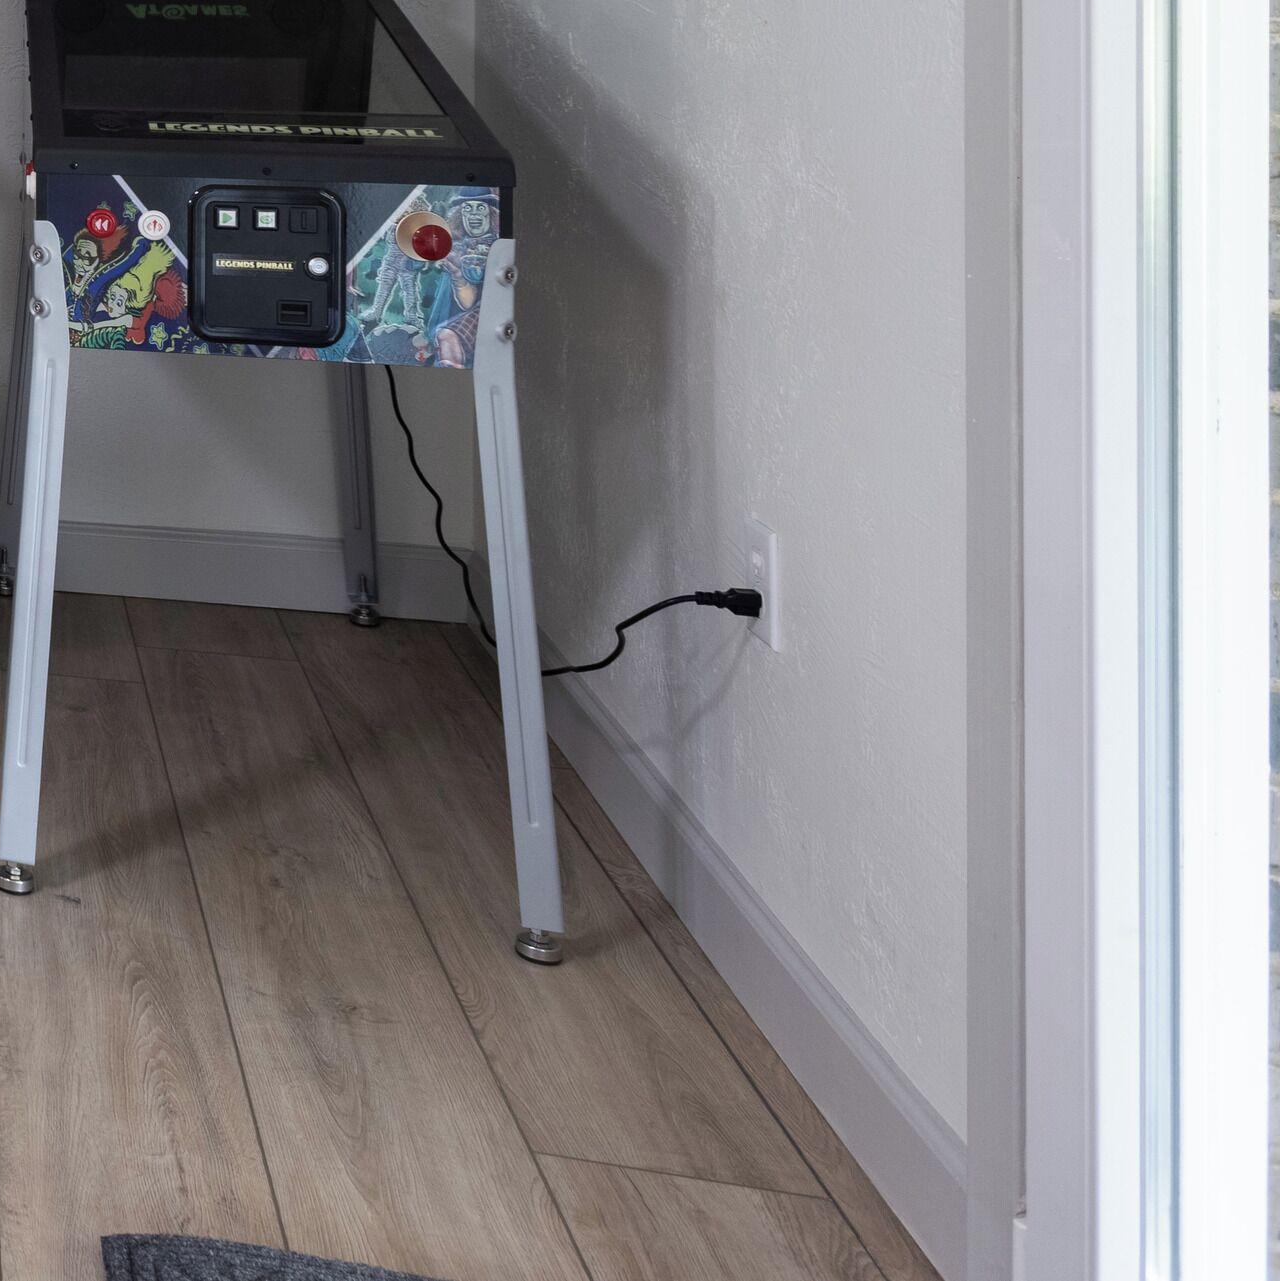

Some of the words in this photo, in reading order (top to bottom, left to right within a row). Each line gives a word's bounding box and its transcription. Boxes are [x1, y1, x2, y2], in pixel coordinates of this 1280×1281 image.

[148, 122, 293, 135] LEGENDS
[299, 125, 444, 138] PINBALL
[216, 260, 255, 269] LEGENDS
[256, 262, 294, 271] PINBALL
